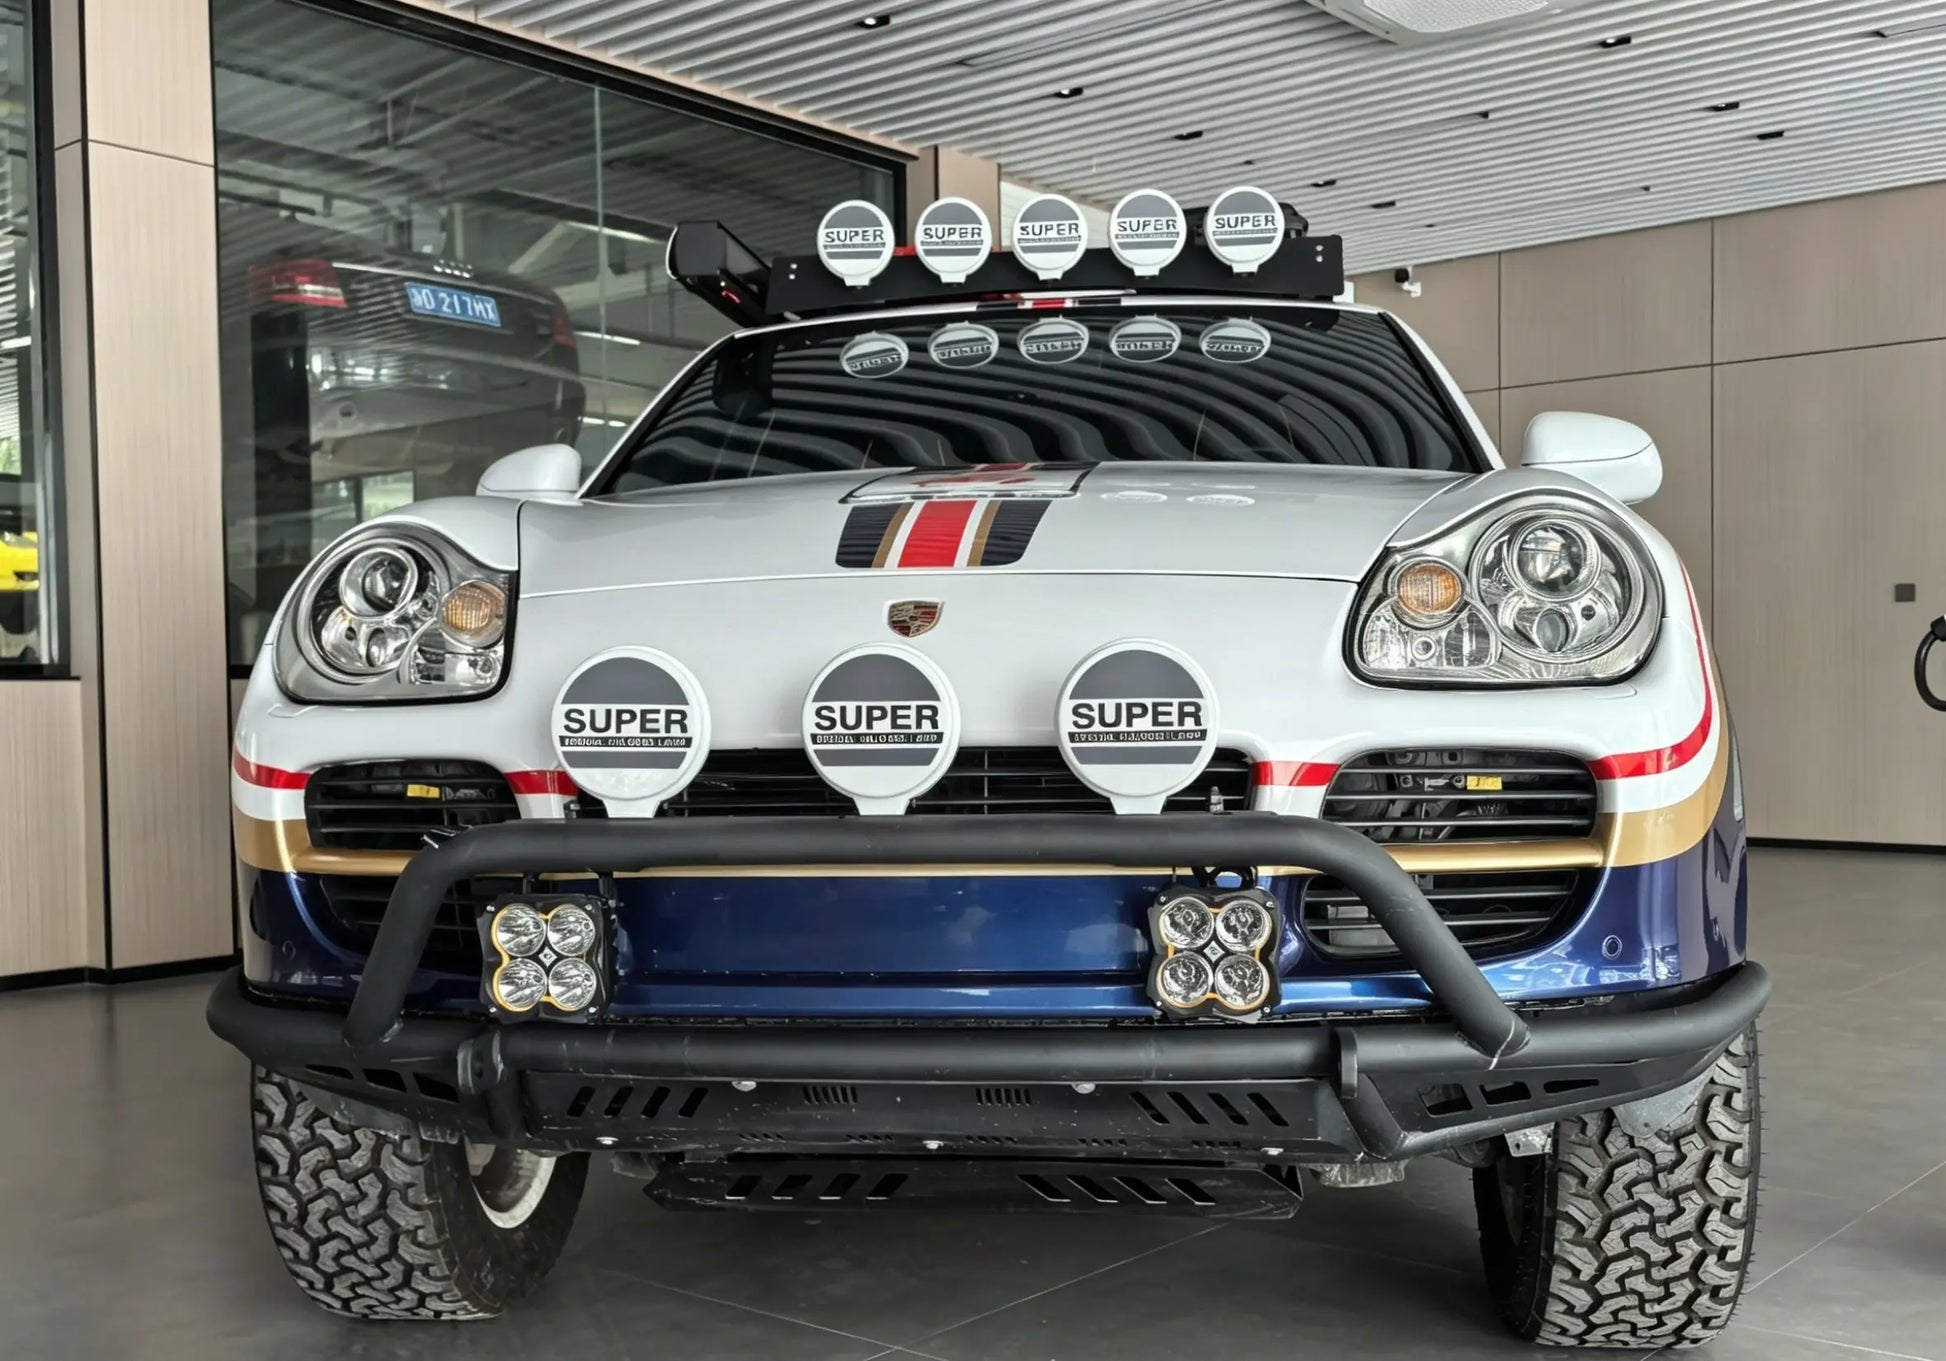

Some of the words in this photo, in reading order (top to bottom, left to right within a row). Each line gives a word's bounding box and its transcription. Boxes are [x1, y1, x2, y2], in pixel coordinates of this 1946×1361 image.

[1118, 219, 1177, 232] SUPER
[1215, 215, 1276, 229] SUPER
[825, 229, 885, 243] SUPER
[923, 227, 982, 240] SUPER
[1020, 223, 1079, 237] SUPER
[563, 708, 688, 734] SUPER
[814, 705, 939, 731] SUPER
[1072, 701, 1202, 729] SUPER
